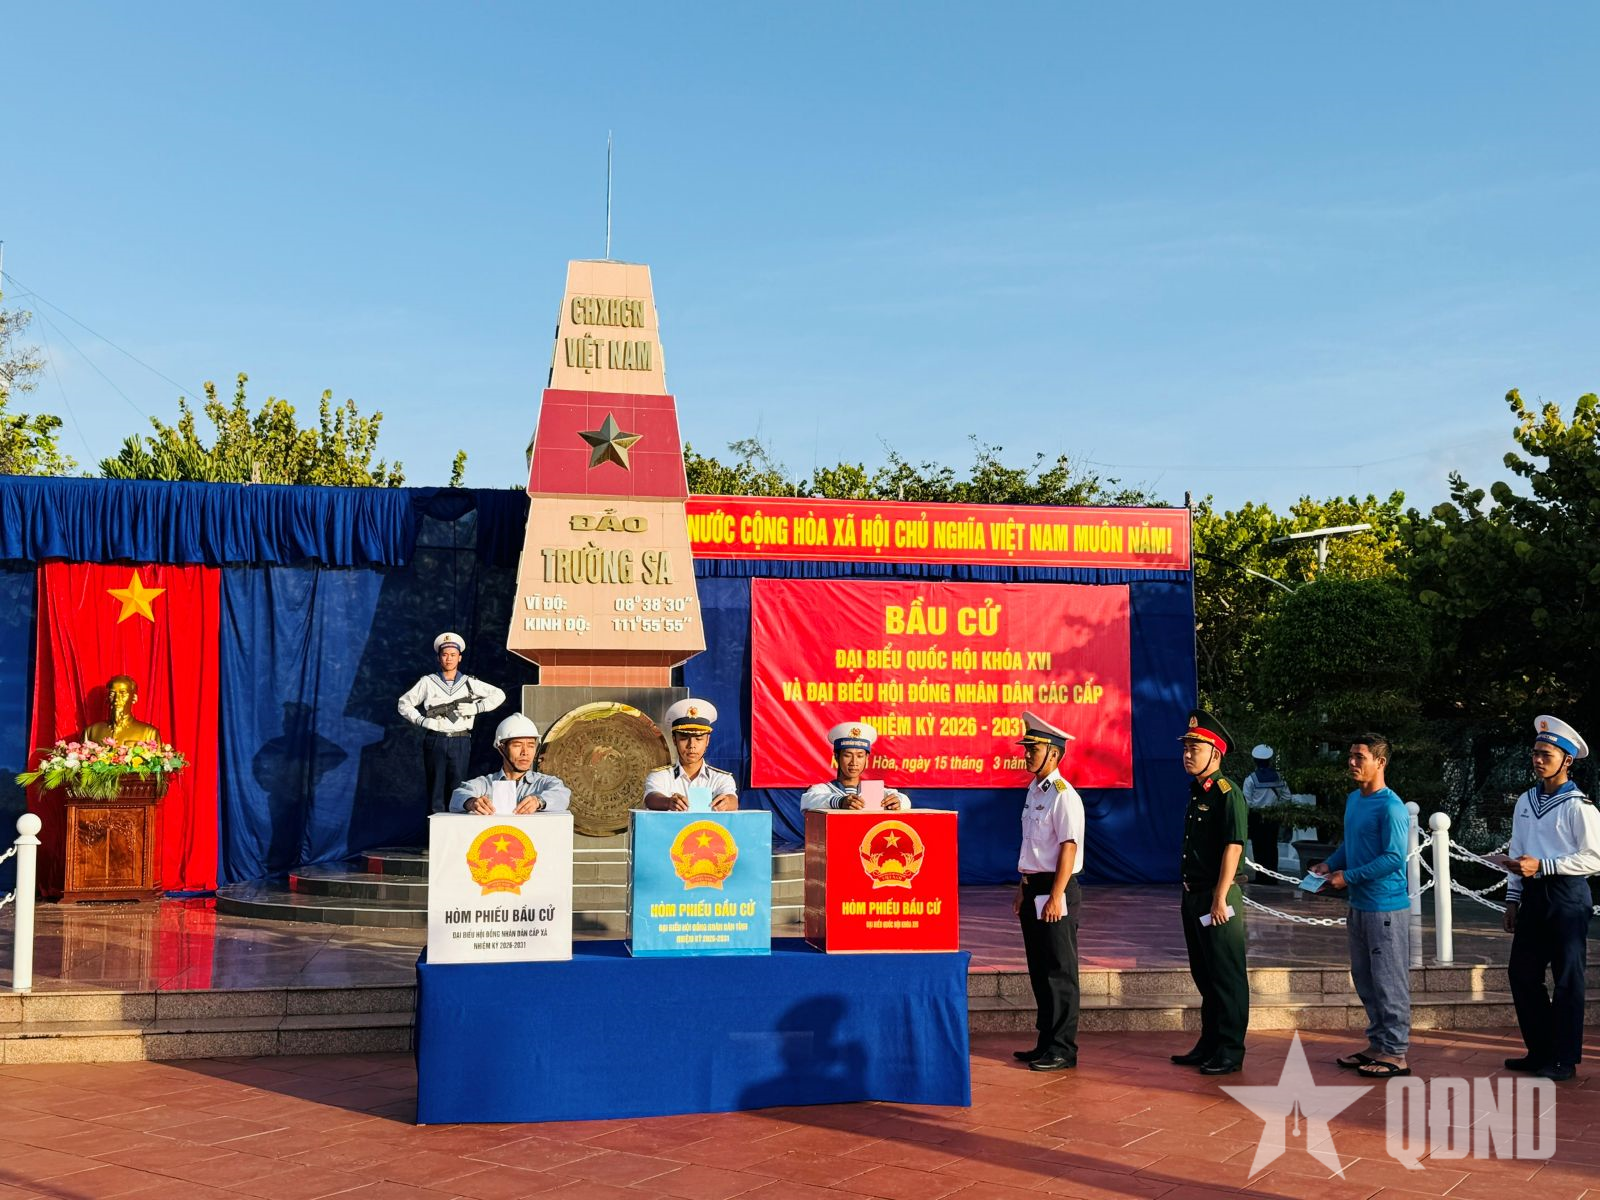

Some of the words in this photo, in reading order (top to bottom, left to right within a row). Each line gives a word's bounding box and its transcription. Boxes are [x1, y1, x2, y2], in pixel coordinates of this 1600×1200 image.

[571, 296, 645, 328] CHXHCN
[565, 332, 605, 374] VIỆT
[608, 340, 653, 371] NAM
[569, 508, 648, 533] ĐẢO
[687, 508, 735, 544] NƯỚC
[740, 510, 788, 550] CỘNG
[793, 510, 828, 546] HÒA
[833, 513, 856, 547] XÃ
[861, 513, 890, 553] HỘI
[894, 511, 929, 549] CHỦ
[934, 516, 986, 550] NGHĨA
[990, 517, 1025, 556] VIỆT
[1029, 523, 1068, 552] NAM
[1074, 519, 1123, 553] MUÔN
[1128, 520, 1172, 554] NĂM!
[541, 541, 634, 584] TRƯỜNG
[642, 550, 673, 584] SA
[524, 593, 541, 610] VĨ
[542, 594, 568, 614] ĐỘ:
[885, 596, 947, 635] BẦU
[957, 597, 1001, 636] CỬ
[524, 617, 561, 631] KINH
[564, 614, 591, 636] ĐỘ:
[835, 649, 862, 672] ĐẠI
[867, 642, 902, 669] BIỂU
[906, 644, 947, 671] QUỐC
[952, 647, 977, 674] HỘI
[982, 647, 1022, 670] KHÓA
[1027, 651, 1051, 670] XVI
[782, 677, 802, 701] VÀ
[806, 681, 833, 706] ĐẠI
[837, 674, 873, 702] BIỂU
[878, 679, 903, 706] HỘI
[908, 676, 950, 703] ĐỒNG
[955, 680, 998, 703] NHÂN
[1002, 681, 1033, 704] DÂN
[1038, 680, 1069, 704] CÁC
[1073, 677, 1103, 705] CẤP
[916, 712, 935, 736] KỲ
[940, 716, 977, 737] 2026
[992, 716, 1027, 737] 2031
[872, 755, 898, 771] Hòa,
[902, 755, 931, 773] ngày
[934, 757, 948, 769] 15
[950, 755, 983, 773] tháng
[993, 756, 1001, 769] 3
[445, 907, 472, 924] HÒM
[475, 905, 509, 923] PHIẾU
[538, 904, 555, 921] CỬ
[651, 901, 676, 917] HÒM
[679, 899, 711, 917] PHIẾU
[740, 898, 756, 916] CỬ
[842, 898, 866, 915] HÒM
[869, 897, 900, 915] PHIẾU
[926, 897, 942, 915] CỬ
